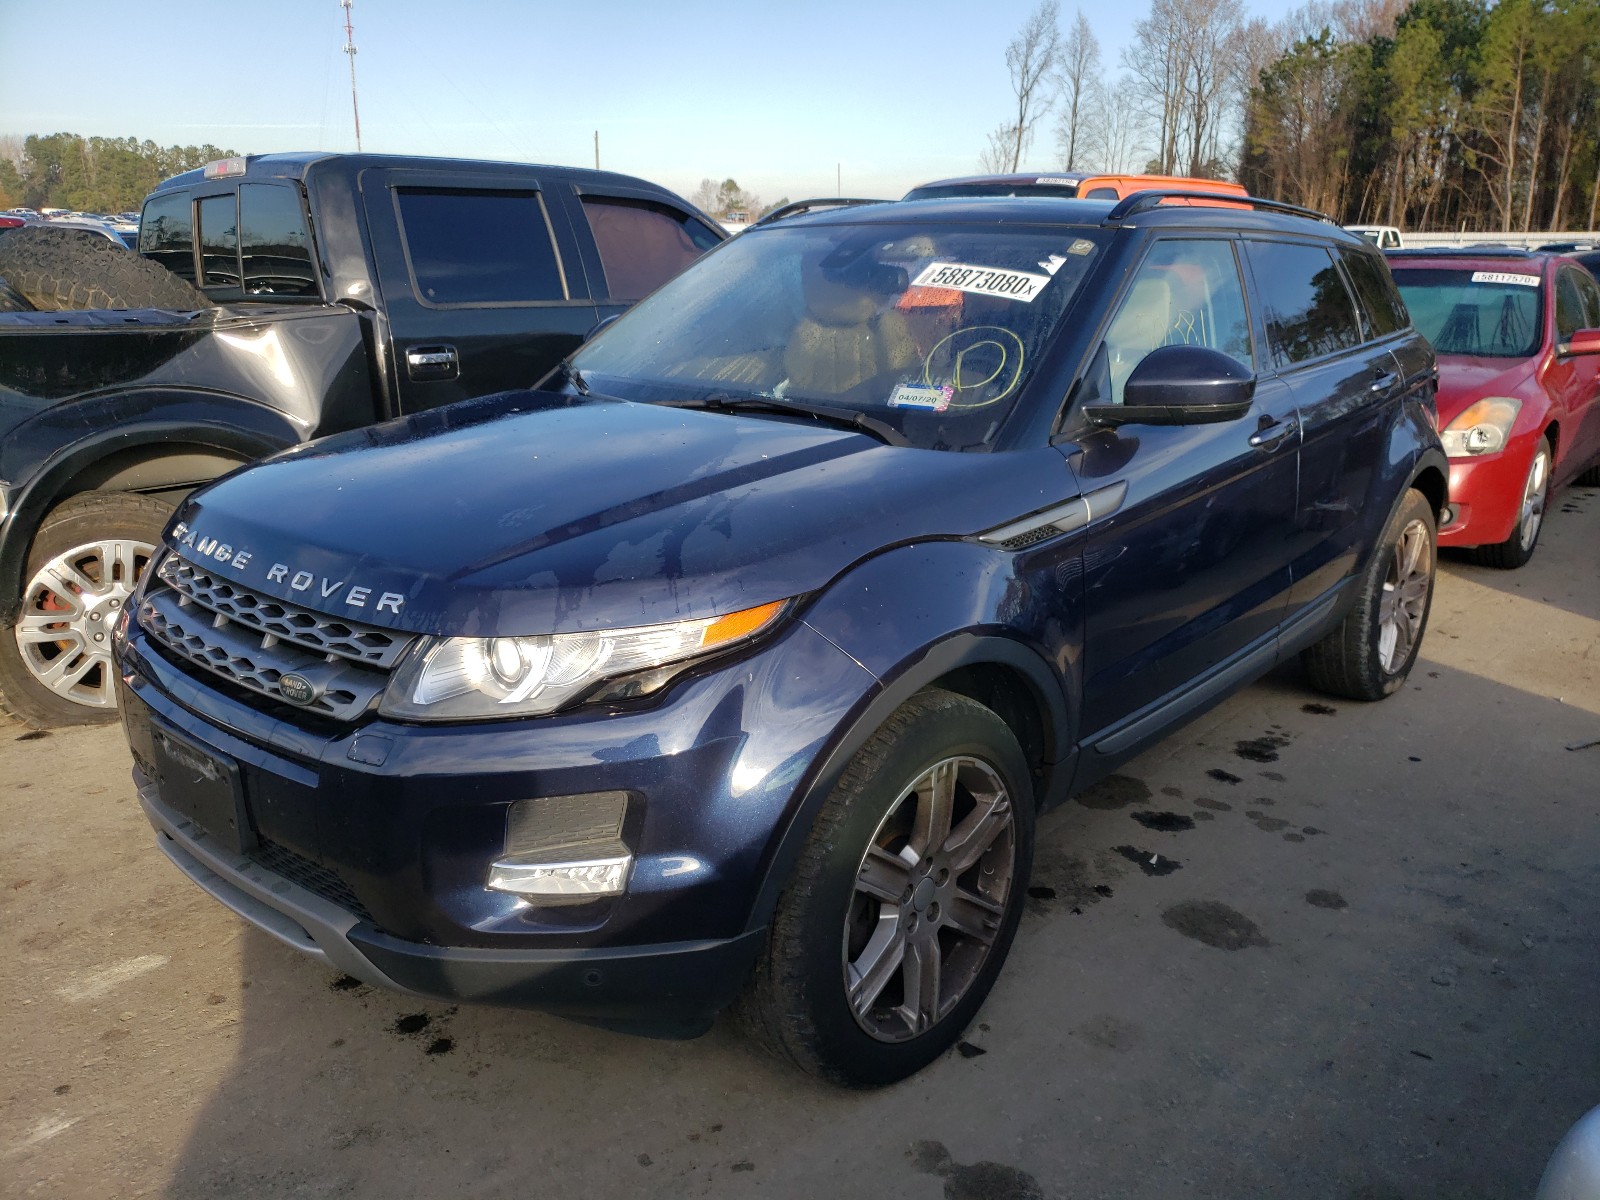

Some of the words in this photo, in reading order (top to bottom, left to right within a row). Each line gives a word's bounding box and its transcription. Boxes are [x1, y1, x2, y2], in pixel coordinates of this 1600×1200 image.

[898, 394, 937, 403] 04/07/20
[172, 521, 252, 570] RANGE
[266, 562, 405, 614] ROVER
[284, 678, 303, 690] LAND
[285, 686, 307, 700] ROVER
